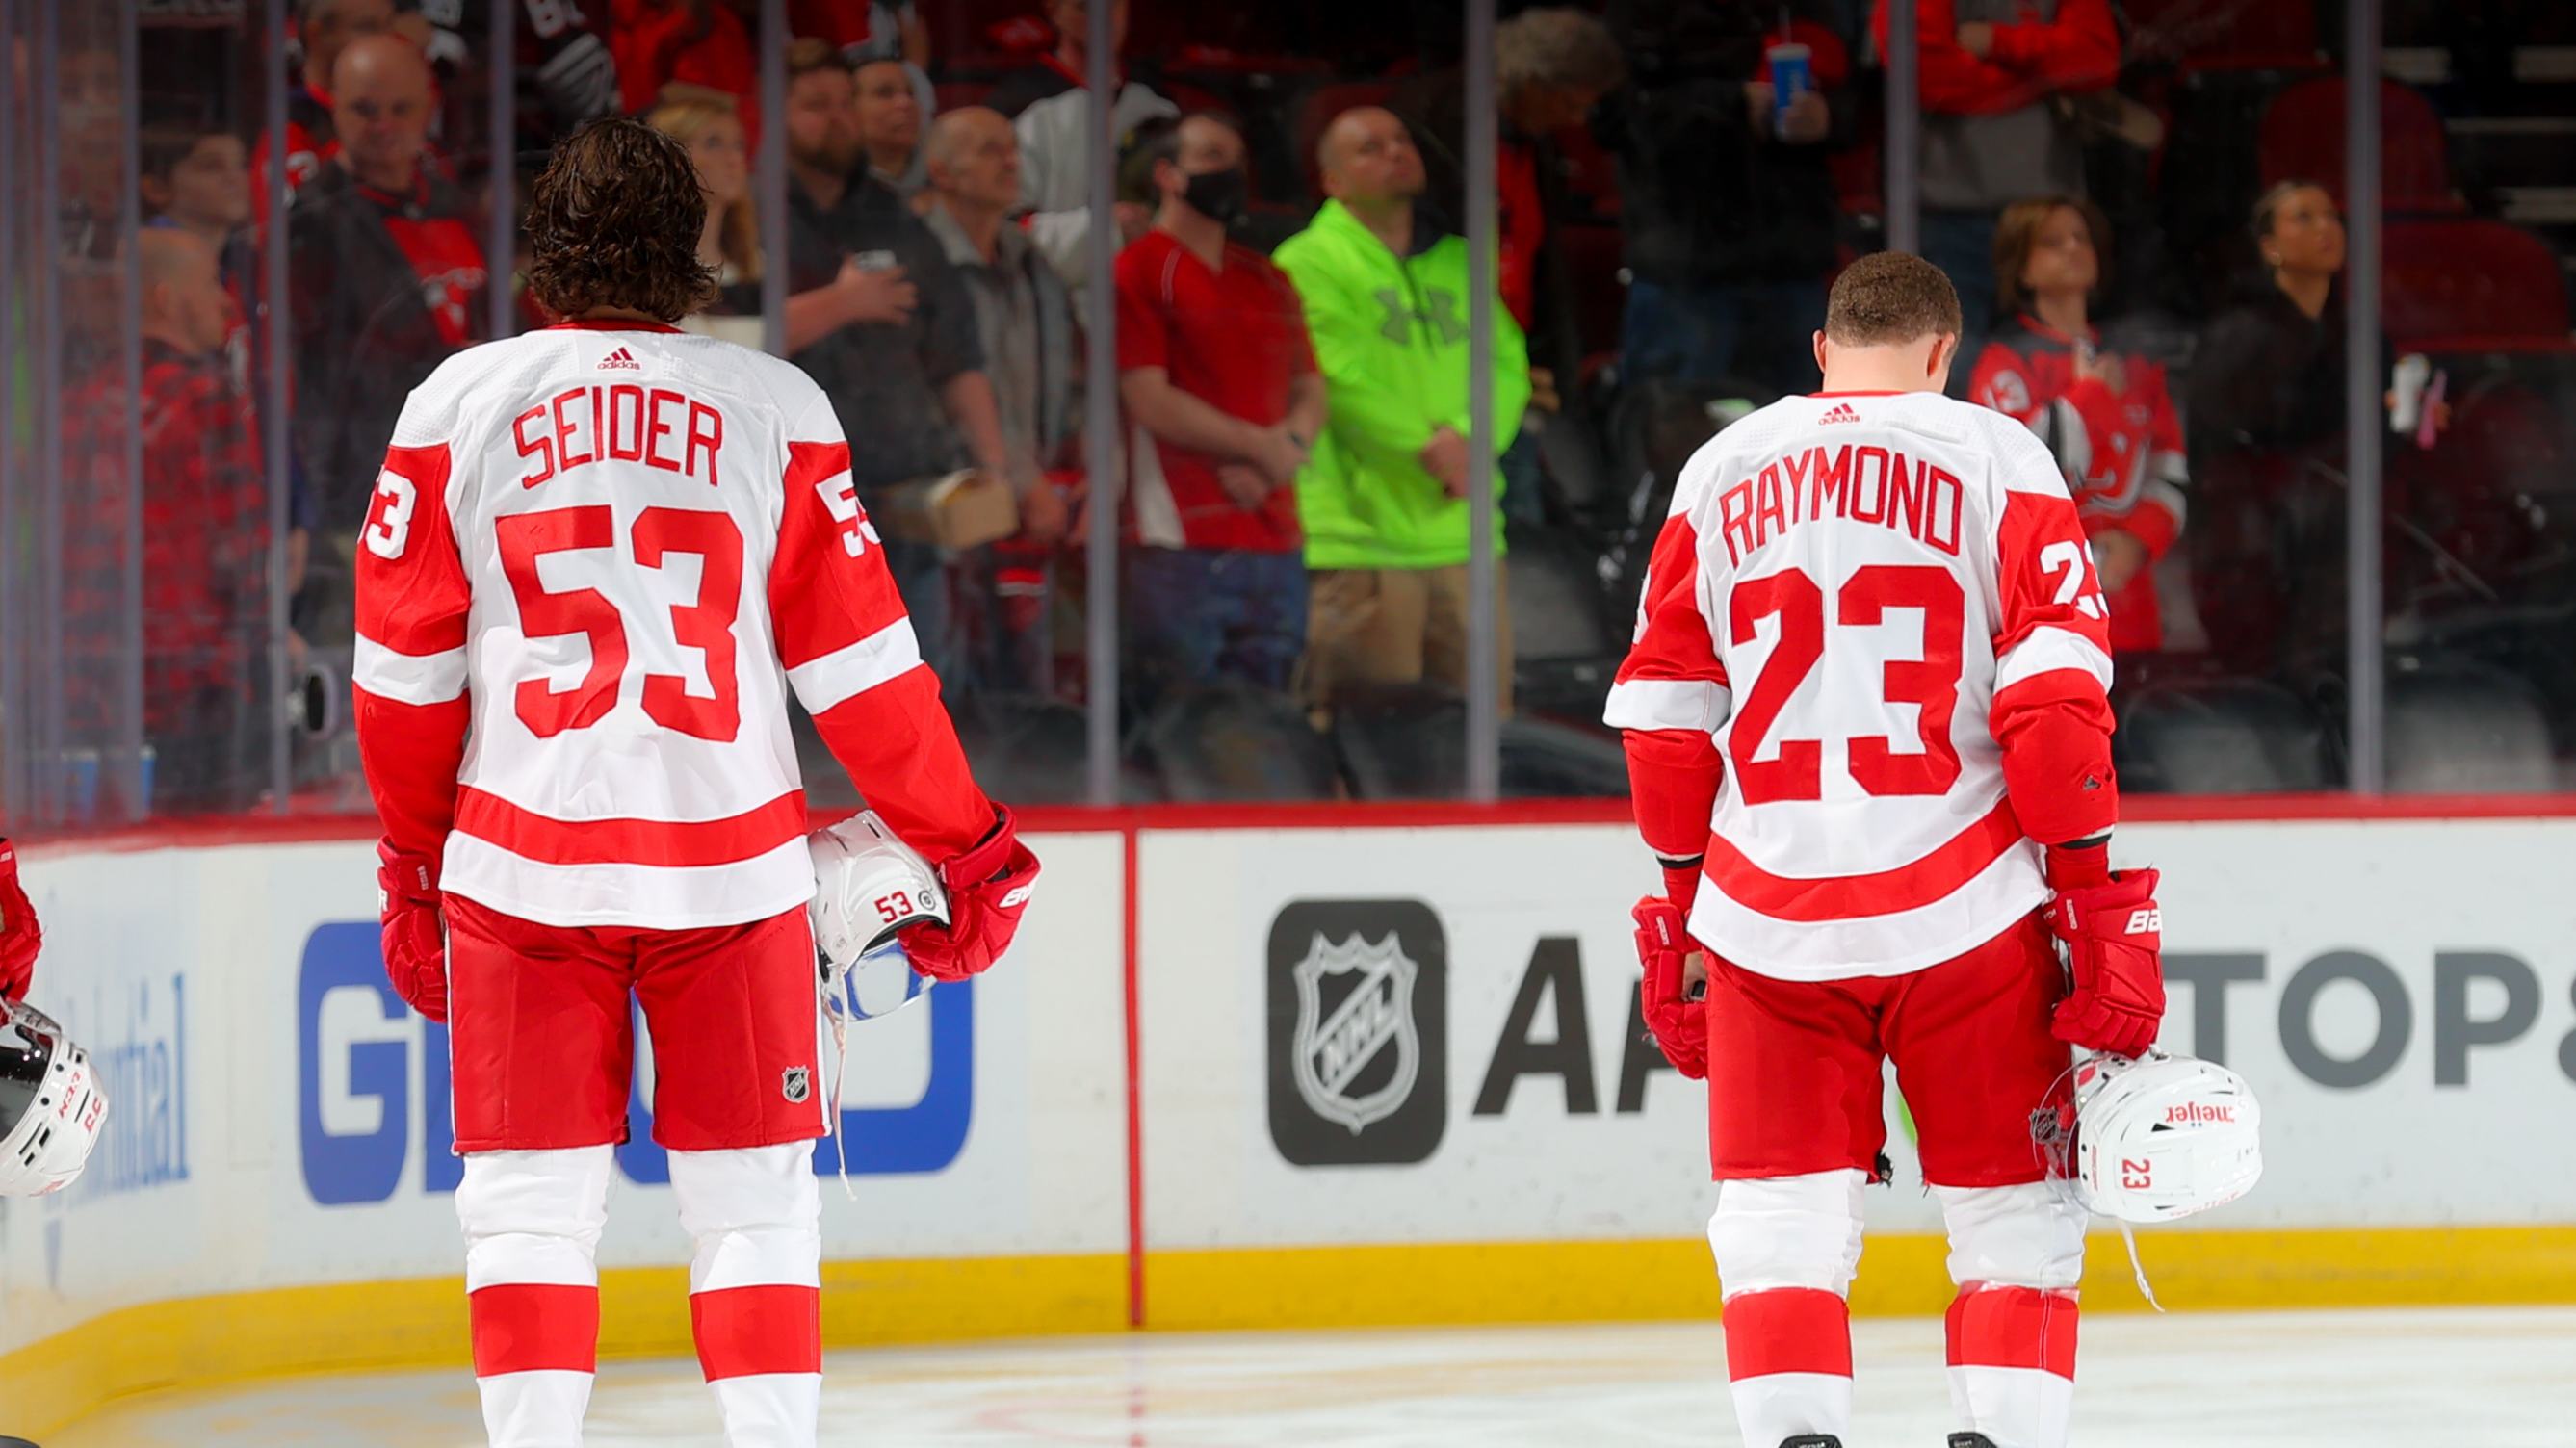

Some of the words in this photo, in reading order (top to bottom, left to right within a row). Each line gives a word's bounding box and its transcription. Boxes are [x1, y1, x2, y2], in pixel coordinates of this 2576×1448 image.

[597, 360, 641, 370] adidas
[512, 384, 722, 490] SEIDER
[357, 463, 417, 560] 3
[1719, 444, 1964, 569] RAYMOND
[495, 504, 744, 743] 53
[2039, 538, 2110, 621] 2
[1729, 564, 1965, 806] 23
[874, 891, 914, 924] 53
[2161, 948, 2576, 1089] TOP
[2165, 1101, 2235, 1127] meijer
[2121, 1158, 2151, 1189] 23
